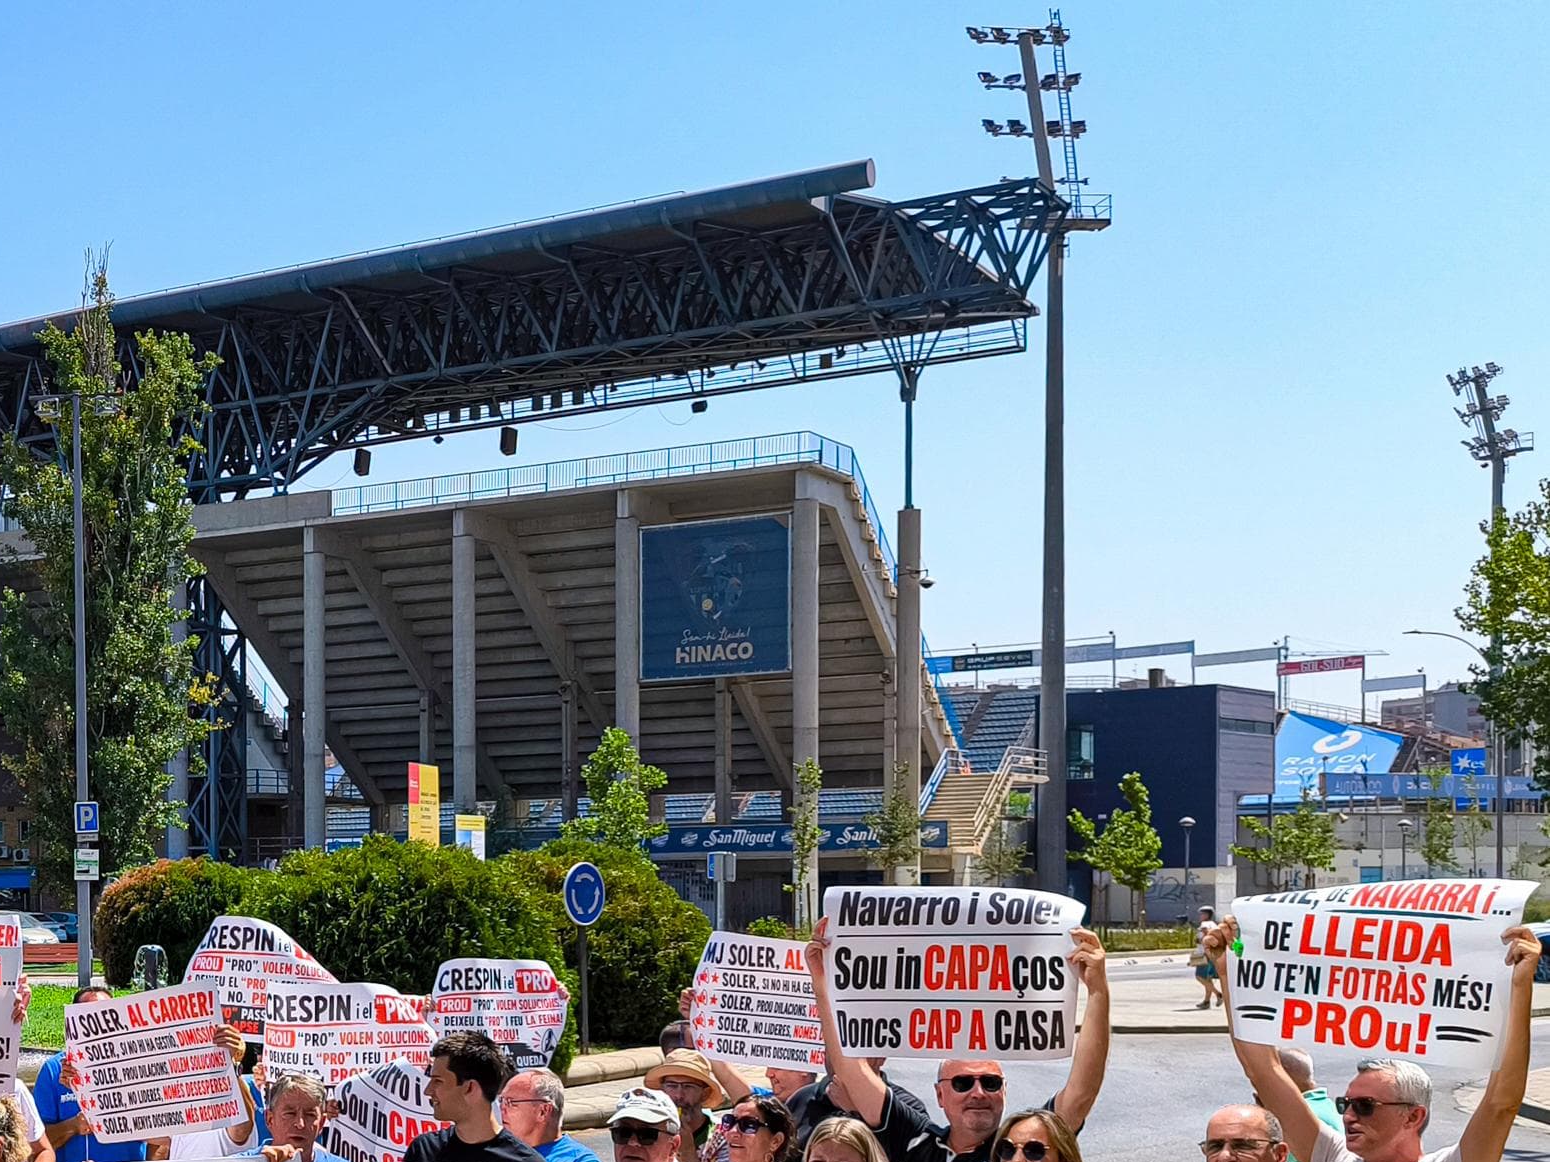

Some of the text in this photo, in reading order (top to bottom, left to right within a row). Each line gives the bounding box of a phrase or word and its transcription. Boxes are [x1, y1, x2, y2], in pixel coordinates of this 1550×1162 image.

[675, 642, 754, 665] HINACO
[79, 805, 94, 830] P
[837, 891, 1063, 928] Navarro i Soler
[1349, 883, 1482, 914] NAVARRA
[1263, 913, 1453, 967] DE LLEIDA
[728, 943, 804, 971] SOLER, AL
[438, 967, 501, 993] CRESPIN
[722, 972, 759, 991] SOLER,
[834, 943, 1065, 999] Sou inCAPAços
[1236, 958, 1493, 1012] NO TE'N FOTRÀS MÉS!
[78, 990, 215, 1038] SOLER, AL CARRER!
[266, 993, 351, 1023] CRESPIN
[440, 999, 469, 1012] PROU
[720, 993, 754, 1013] SOLER,
[444, 1016, 475, 1027] DEIXEU
[717, 1015, 750, 1034] SOLER,
[836, 1008, 1066, 1052] Doncs CAP A CASA
[1280, 997, 1433, 1055] PROu!
[339, 1030, 434, 1046] VOLEM SOLUCIONS.
[493, 1029, 520, 1040] PROU!
[85, 1042, 120, 1062] SOLER,
[716, 1038, 748, 1058] SOLER,
[92, 1066, 123, 1087] SOLER,
[97, 1090, 128, 1111] SOLER,
[103, 1114, 134, 1135] SOLER,
